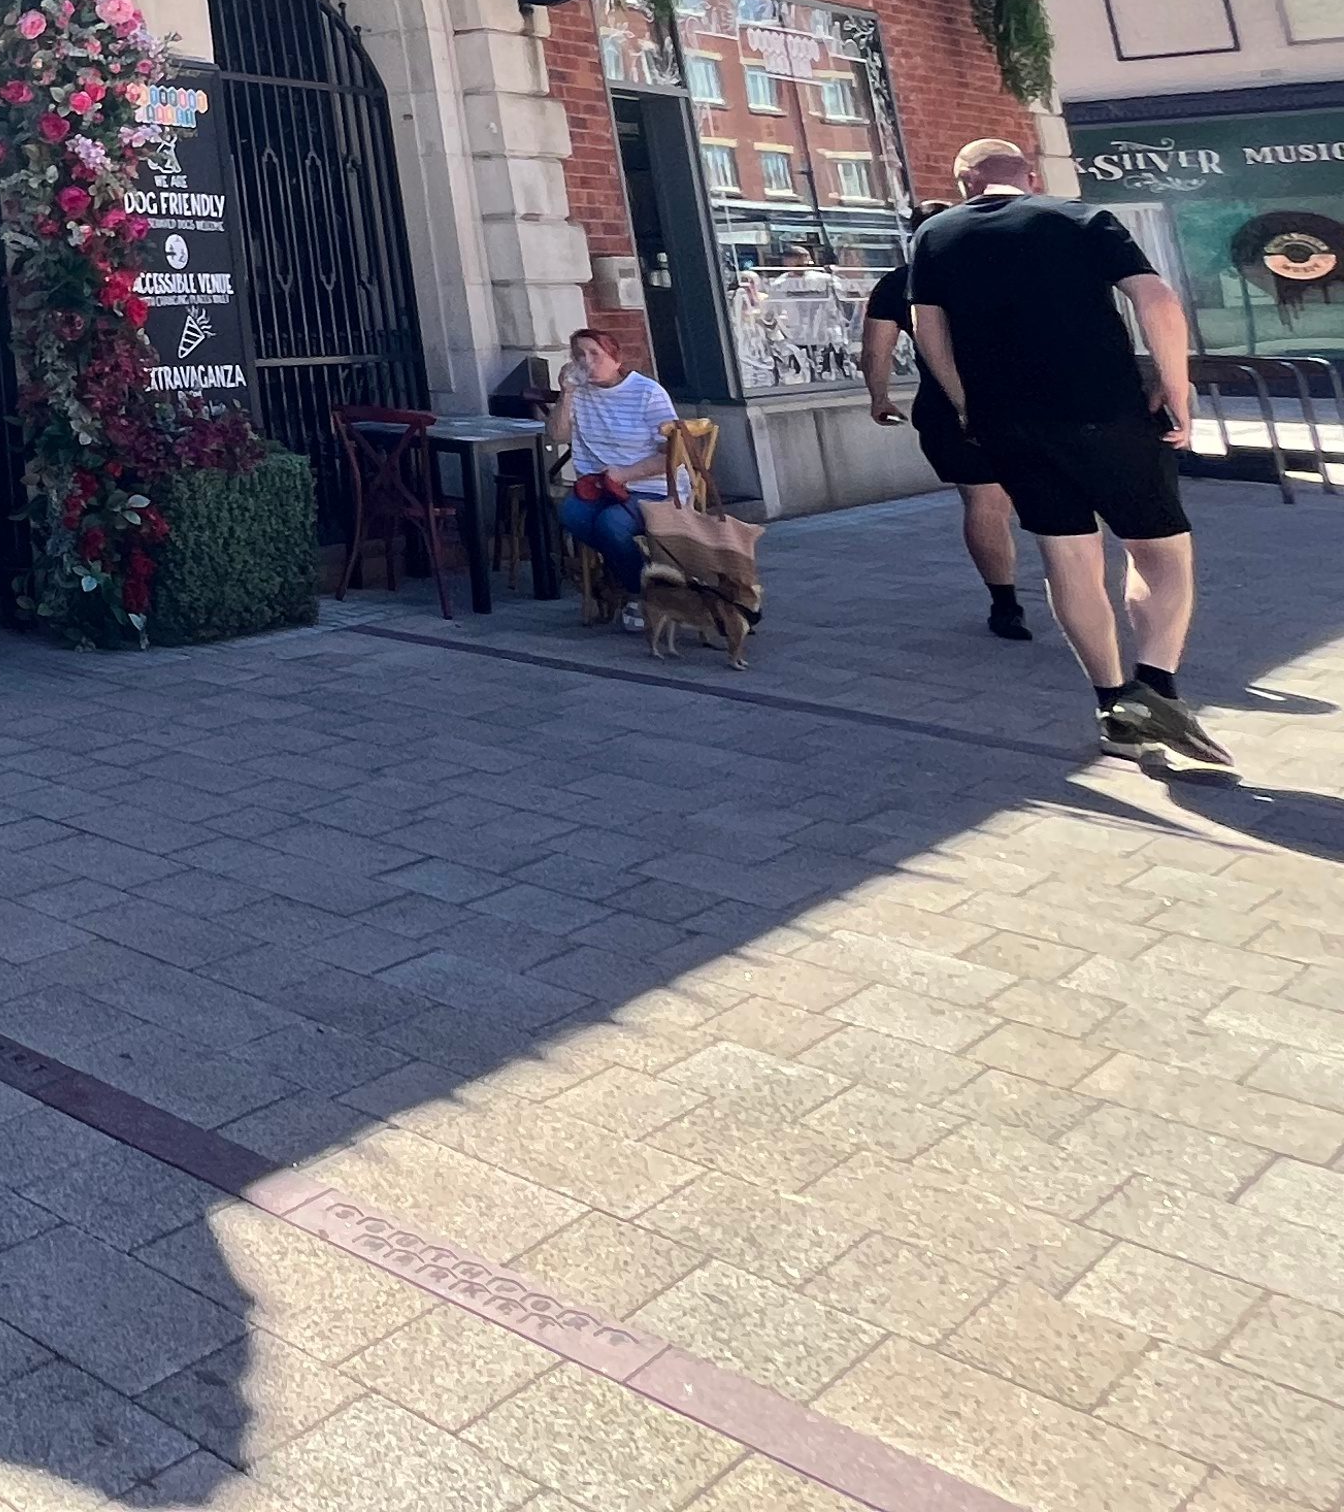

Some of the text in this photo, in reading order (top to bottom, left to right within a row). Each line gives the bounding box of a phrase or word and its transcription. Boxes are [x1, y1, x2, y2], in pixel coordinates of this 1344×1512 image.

[1241, 141, 1344, 165] MUSIC
[154, 175, 188, 188] WE ARE
[124, 191, 225, 218] DOG FRIENDLY
[197, 272, 234, 294] VENUE
[143, 365, 247, 391] XTRAVAGANZA
